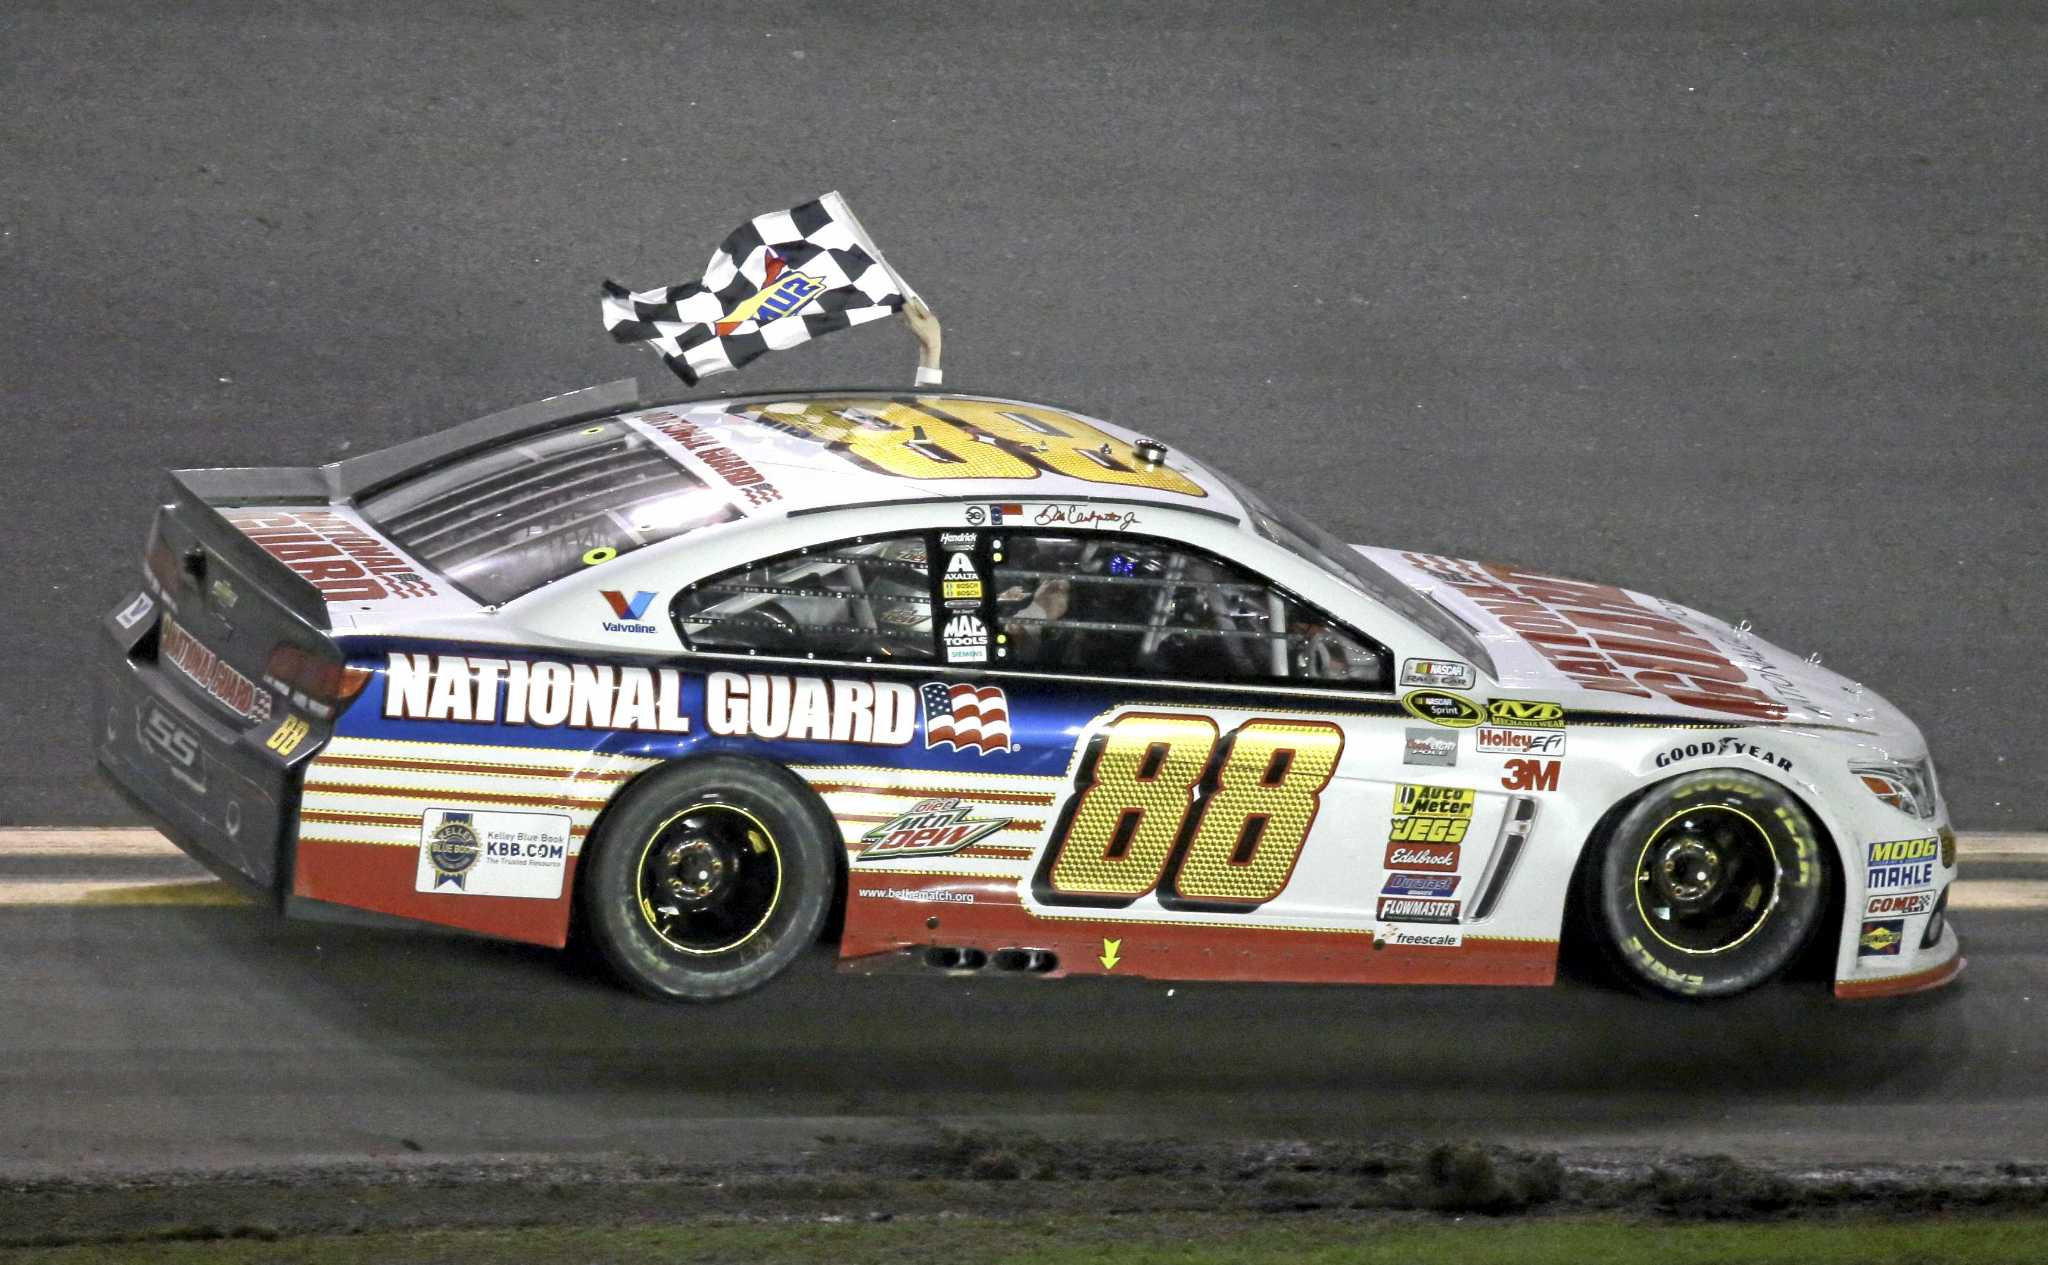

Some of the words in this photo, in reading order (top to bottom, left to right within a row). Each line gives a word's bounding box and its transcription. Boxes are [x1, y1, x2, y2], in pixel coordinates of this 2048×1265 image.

[941, 533, 977, 545] Hendrick
[602, 622, 657, 634] Valvoline
[944, 615, 988, 637] MAC
[944, 637, 988, 645] TOOLS
[1430, 664, 1463, 676] NASCAR
[385, 652, 690, 734] NATIONAL
[706, 671, 917, 747] GUARD
[1431, 706, 1459, 716] Sprint
[266, 714, 311, 757] 88
[1480, 730, 1532, 752] Holley
[1501, 758, 1561, 792] 3M
[1032, 711, 1345, 913] 88
[487, 832, 515, 842] Kelley
[517, 832, 538, 840] Blue
[541, 833, 564, 842] Book
[1390, 816, 1471, 843] JEGS
[487, 842, 563, 858] KBB.COM
[1390, 848, 1454, 866] Edelbrock
[1871, 840, 1936, 861] MOOG
[1869, 864, 1932, 888] MAHLE
[1381, 900, 1455, 919] FLOWMASTER
[1868, 896, 1920, 913] COMP
[1397, 933, 1456, 945] freescale
